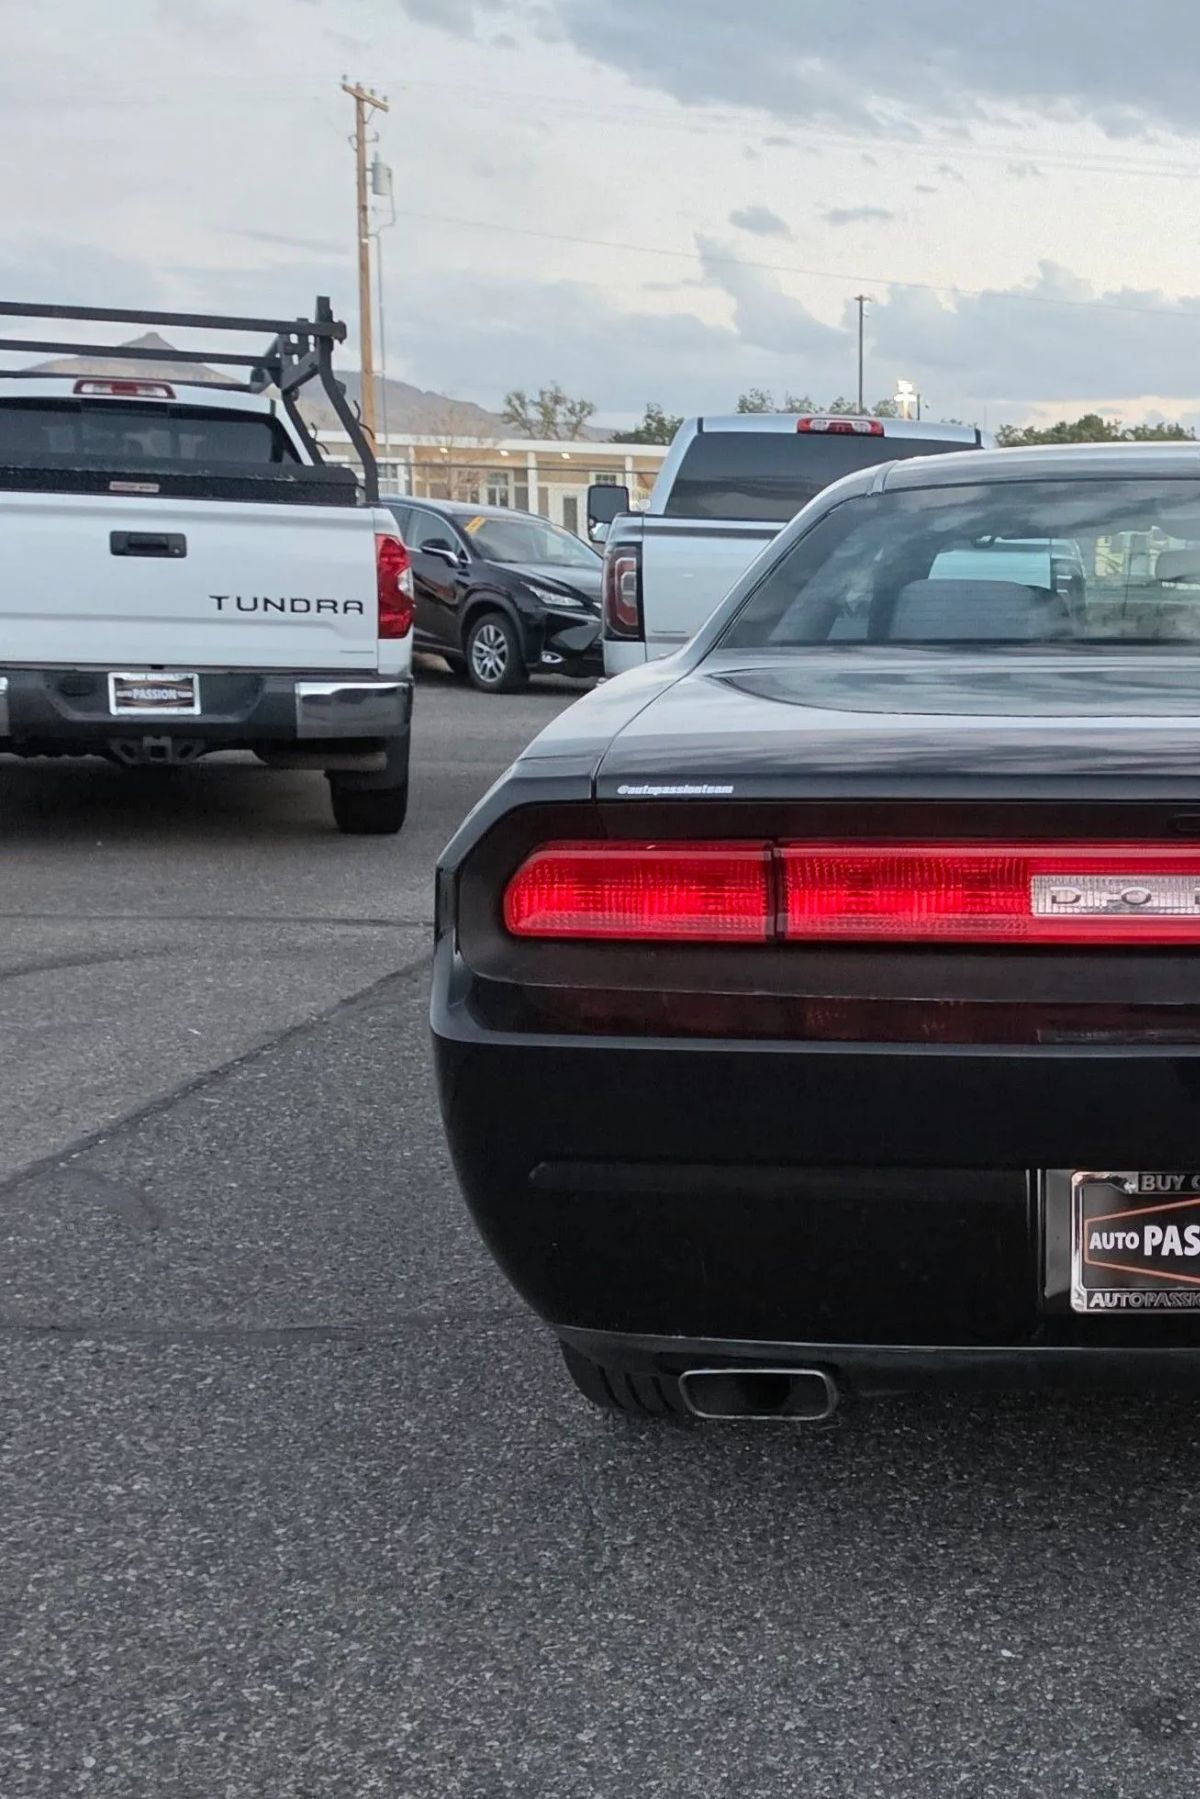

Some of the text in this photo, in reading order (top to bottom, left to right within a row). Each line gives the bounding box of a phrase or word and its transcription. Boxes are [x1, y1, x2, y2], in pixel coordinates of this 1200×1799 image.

[208, 595, 364, 615] TUNDRA
[132, 689, 177, 700] PASSION
[617, 785, 734, 796] @autopassionteam
[1141, 1174, 1183, 1191] BUY
[1089, 1231, 1140, 1250] AUTO
